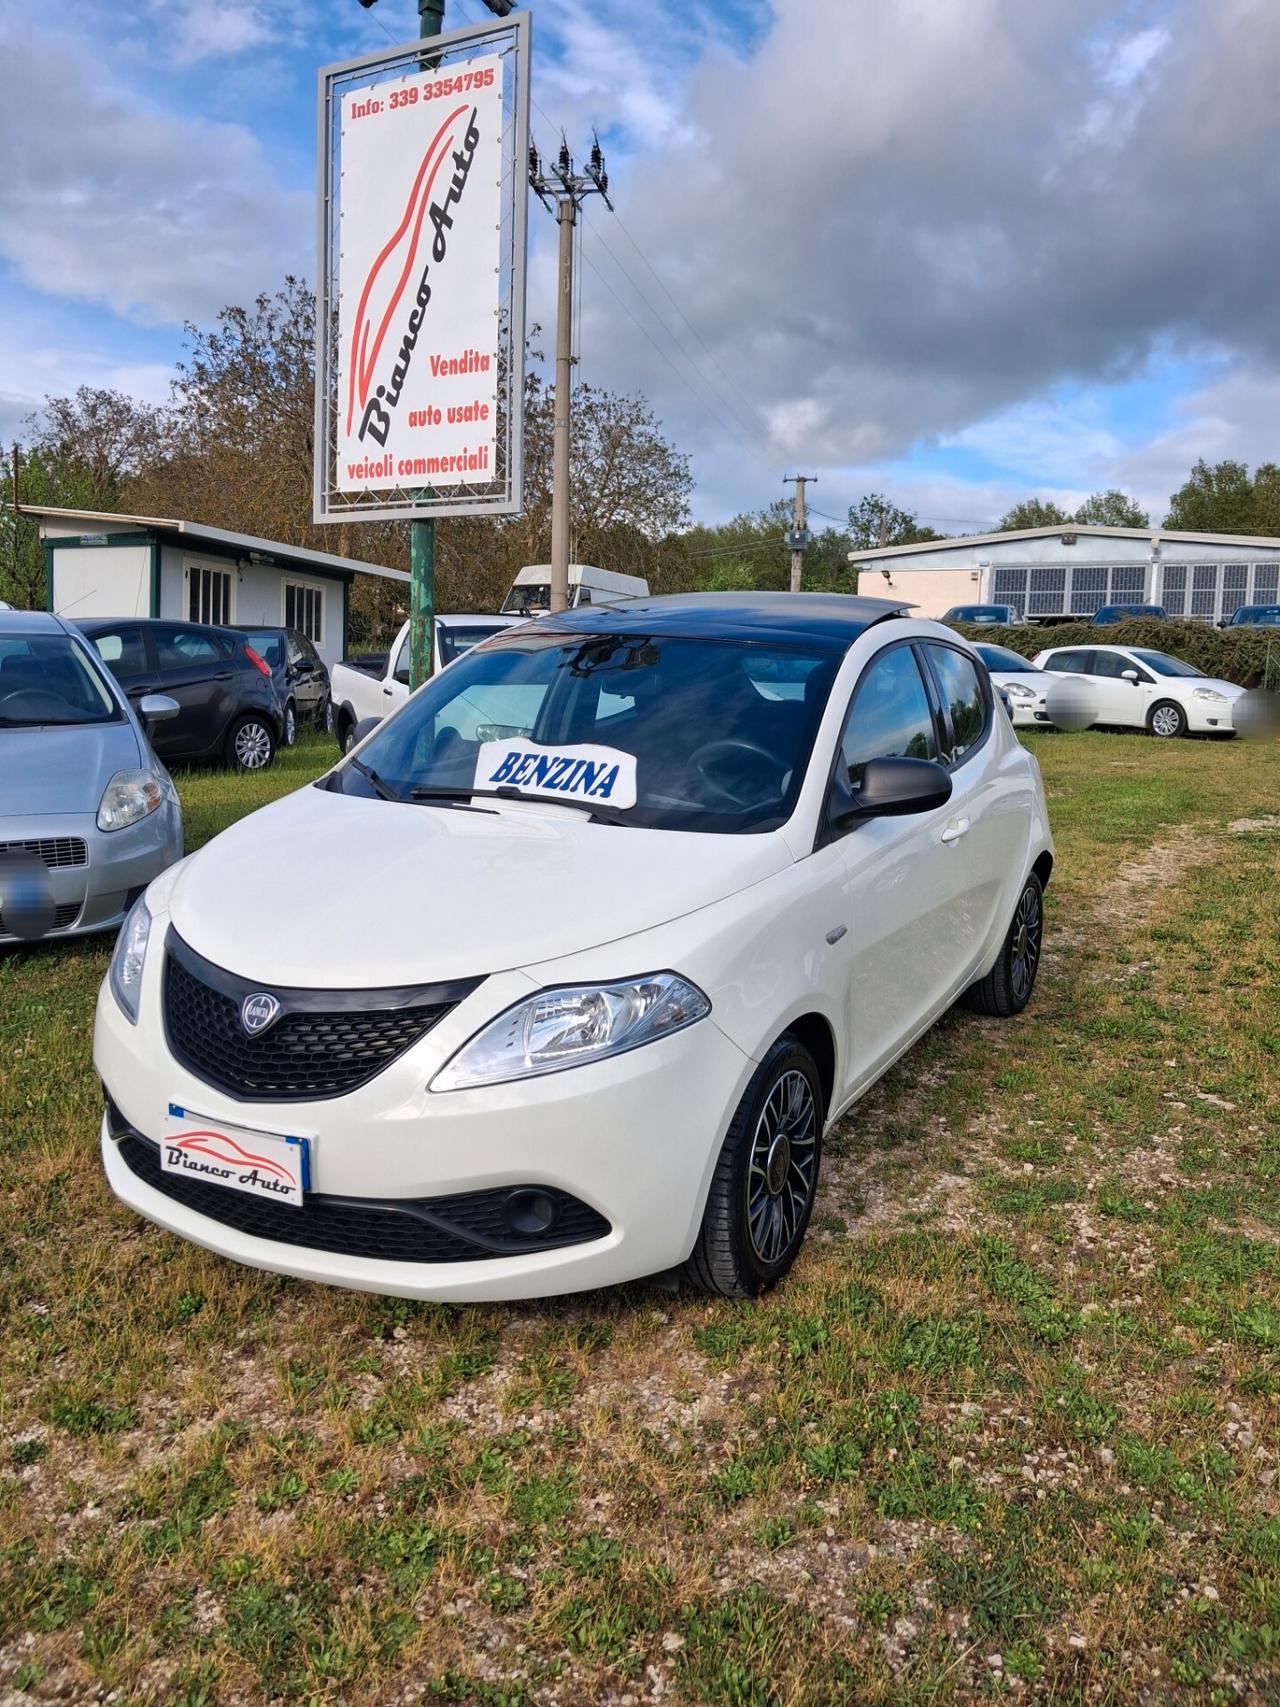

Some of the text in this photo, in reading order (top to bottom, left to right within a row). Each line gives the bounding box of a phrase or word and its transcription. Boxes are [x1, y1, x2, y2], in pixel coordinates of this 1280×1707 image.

[351, 68, 495, 120] Info: 339 3354795
[358, 107, 480, 447] Bianco Auto
[430, 349, 490, 377] Vendita
[408, 400, 489, 428] auto usate
[347, 446, 489, 480] veicoli commerciali
[489, 752, 620, 798] BENZINA
[166, 1146, 297, 1196] Bianco Auto
